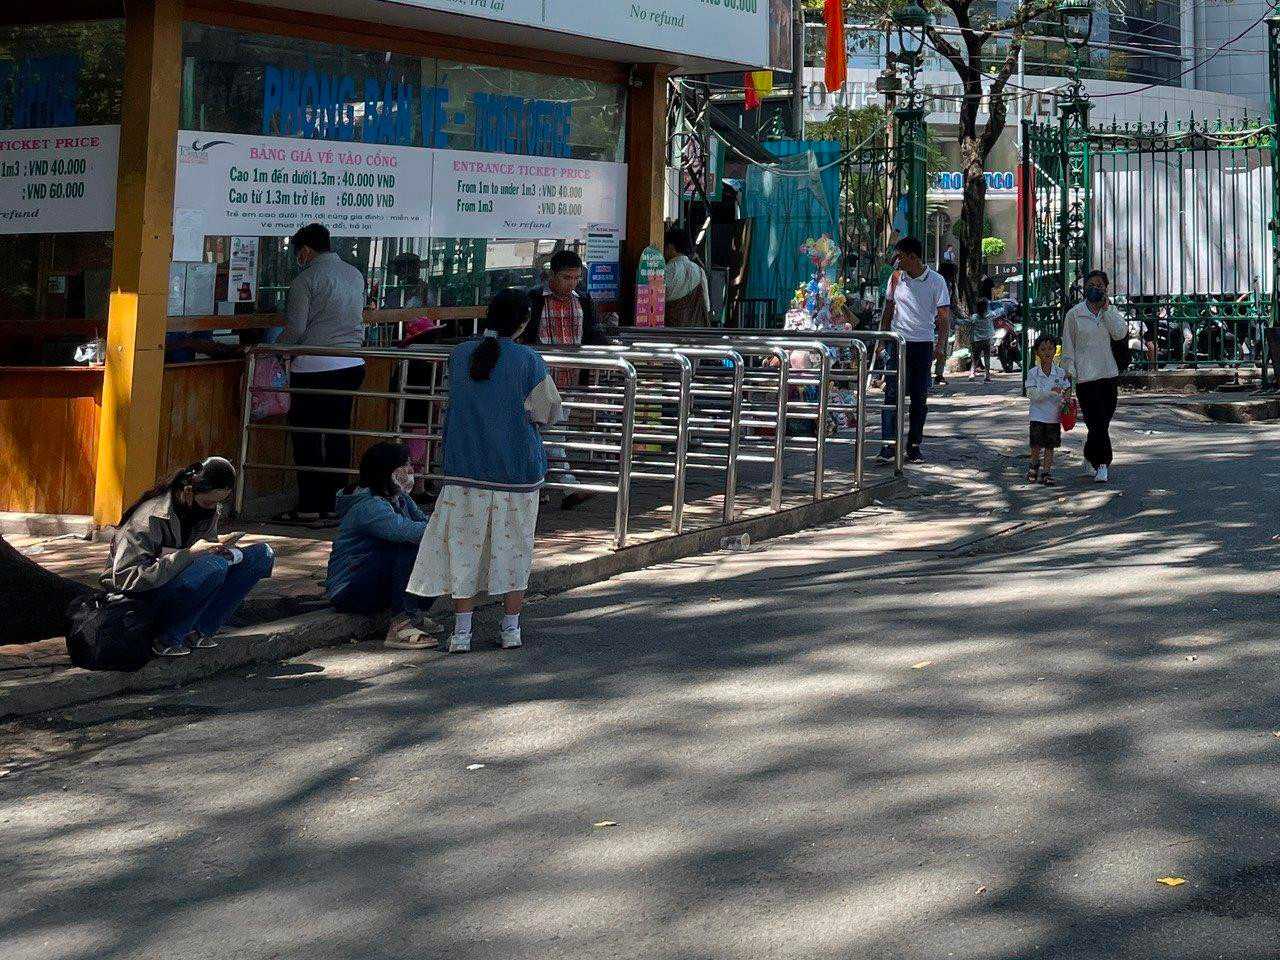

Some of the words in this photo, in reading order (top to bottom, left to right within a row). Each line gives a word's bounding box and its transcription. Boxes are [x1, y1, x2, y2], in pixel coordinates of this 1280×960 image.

[629, 4, 647, 20] No
[649, 9, 685, 28] refund
[54, 136, 100, 149] PRICE
[249, 144, 286, 161] BẢNG
[290, 148, 314, 163] GIÁ
[317, 149, 335, 164] VÉ
[338, 151, 362, 166] VÀO
[366, 149, 398, 168] CỔNG
[1, 160, 20, 177] 1m3
[50, 158, 87, 176] 40.000
[229, 166, 249, 182] Cao
[252, 168, 268, 183] 1m
[271, 167, 289, 184] đến
[453, 160, 515, 175] ENTRANCE
[518, 165, 557, 177] TICKET
[560, 167, 591, 179] PRICE
[49, 181, 85, 199] 60.000
[229, 188, 248, 204] Cao
[251, 190, 263, 205] từ
[266, 190, 290, 205] 1.3m
[293, 190, 309, 206] trở
[310, 192, 326, 206] lên
[457, 180, 477, 194] From
[478, 181, 490, 195] 1m
[491, 182, 499, 195] to
[500, 183, 519, 196] under
[521, 184, 537, 196] 1m3
[558, 185, 583, 198] 40.000
[456, 199, 476, 212] From
[478, 200, 494, 213] 1m3
[557, 202, 582, 216] 60.000
[502, 220, 517, 228] No
[518, 220, 552, 229] refund
